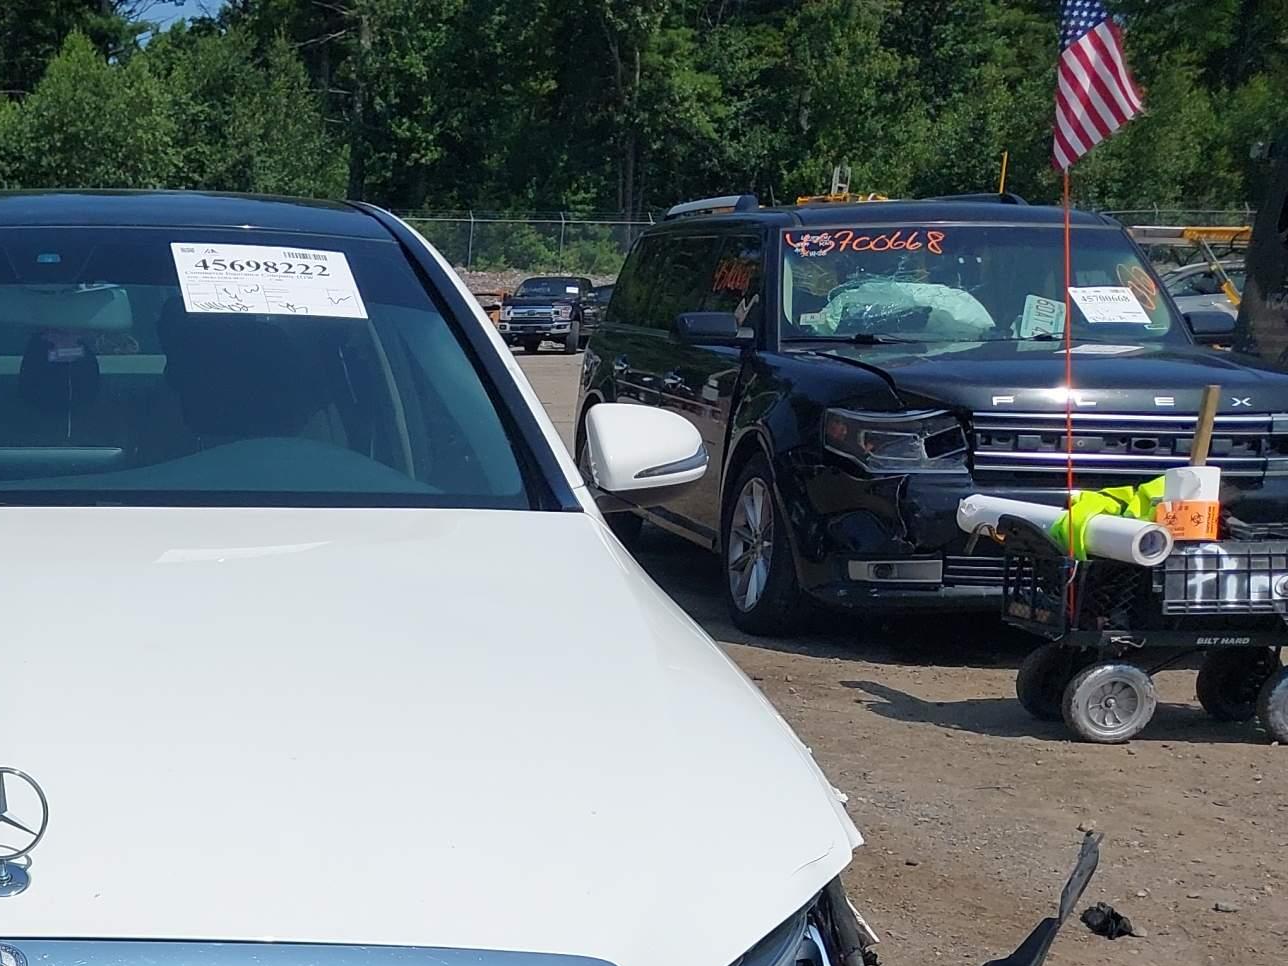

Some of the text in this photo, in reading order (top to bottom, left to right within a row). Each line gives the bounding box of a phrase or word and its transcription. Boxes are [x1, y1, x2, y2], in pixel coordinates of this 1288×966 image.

[194, 258, 330, 277] 45698222
[1196, 637, 1250, 645] BILT HARD
